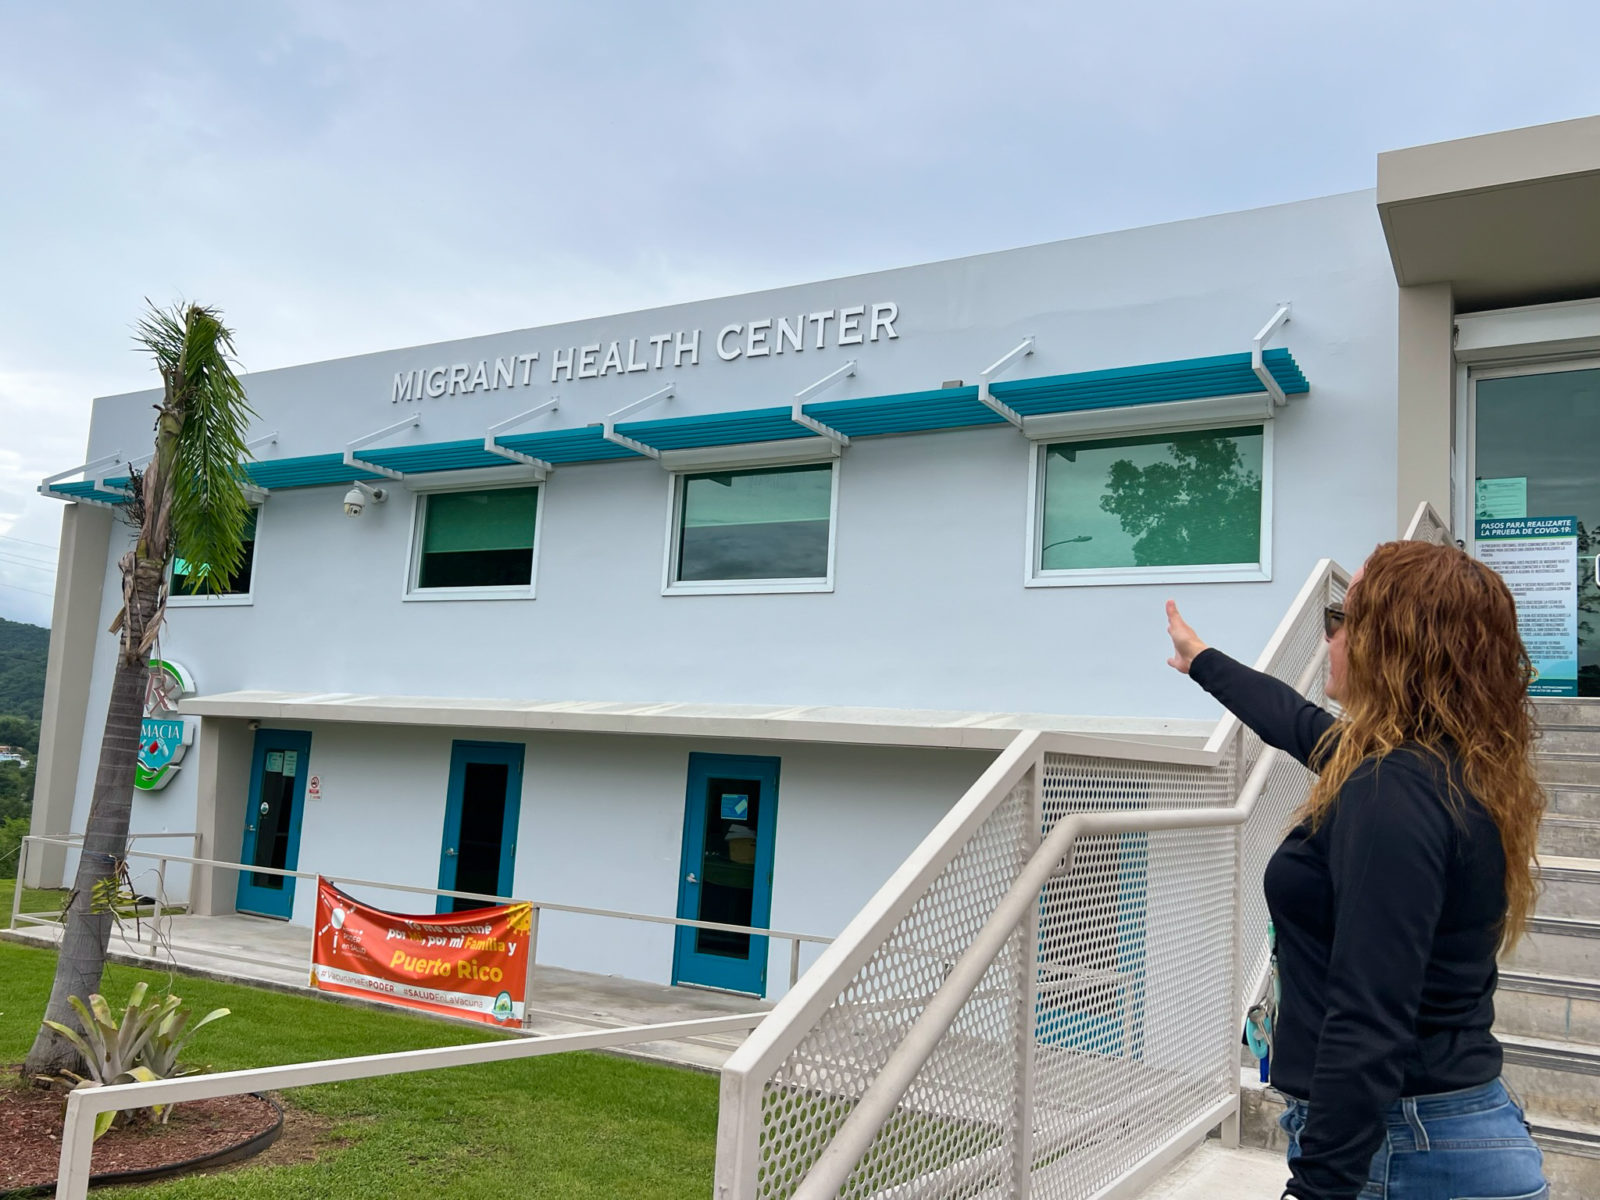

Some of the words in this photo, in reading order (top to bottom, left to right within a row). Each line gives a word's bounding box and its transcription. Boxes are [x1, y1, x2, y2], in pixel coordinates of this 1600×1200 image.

[392, 352, 540, 404] MIGRANT
[551, 329, 702, 383] HEALTH
[716, 302, 899, 360] CENTER
[1481, 522, 1504, 530] PASOS
[1506, 521, 1525, 529] PARA
[1526, 519, 1572, 528] REALIZARTE
[1491, 528, 1520, 536] PRUEBA
[141, 723, 180, 739] MACIA
[422, 923, 442, 933] me
[386, 928, 406, 940] por
[427, 934, 448, 947] por
[449, 934, 465, 949] mi
[507, 941, 518, 956] y
[390, 949, 451, 977] Puerto
[457, 959, 504, 983] Rico
